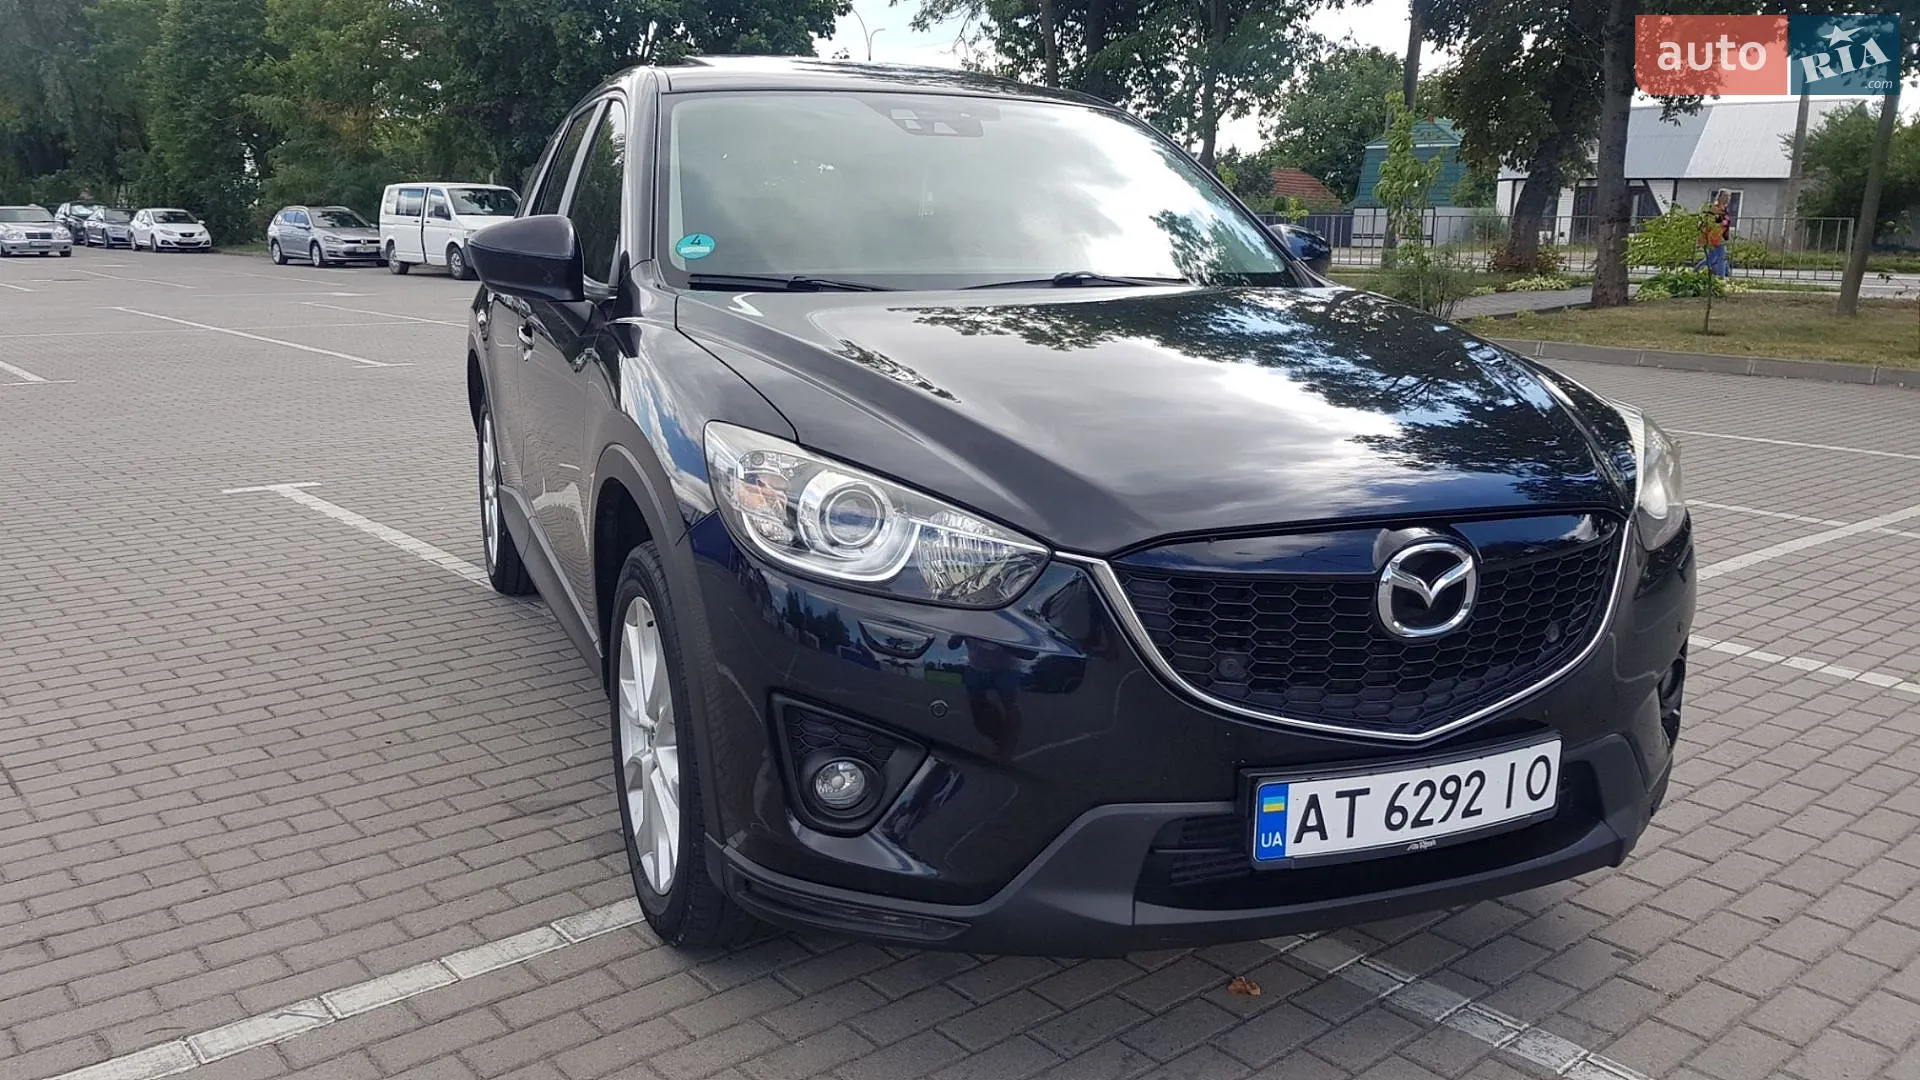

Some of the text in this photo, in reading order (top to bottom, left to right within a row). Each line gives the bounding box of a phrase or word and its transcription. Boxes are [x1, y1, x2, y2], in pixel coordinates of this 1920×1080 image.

[690, 235, 702, 246] 4
[1293, 754, 1551, 844] AT 6292 IO
[1261, 832, 1283, 848] UA
